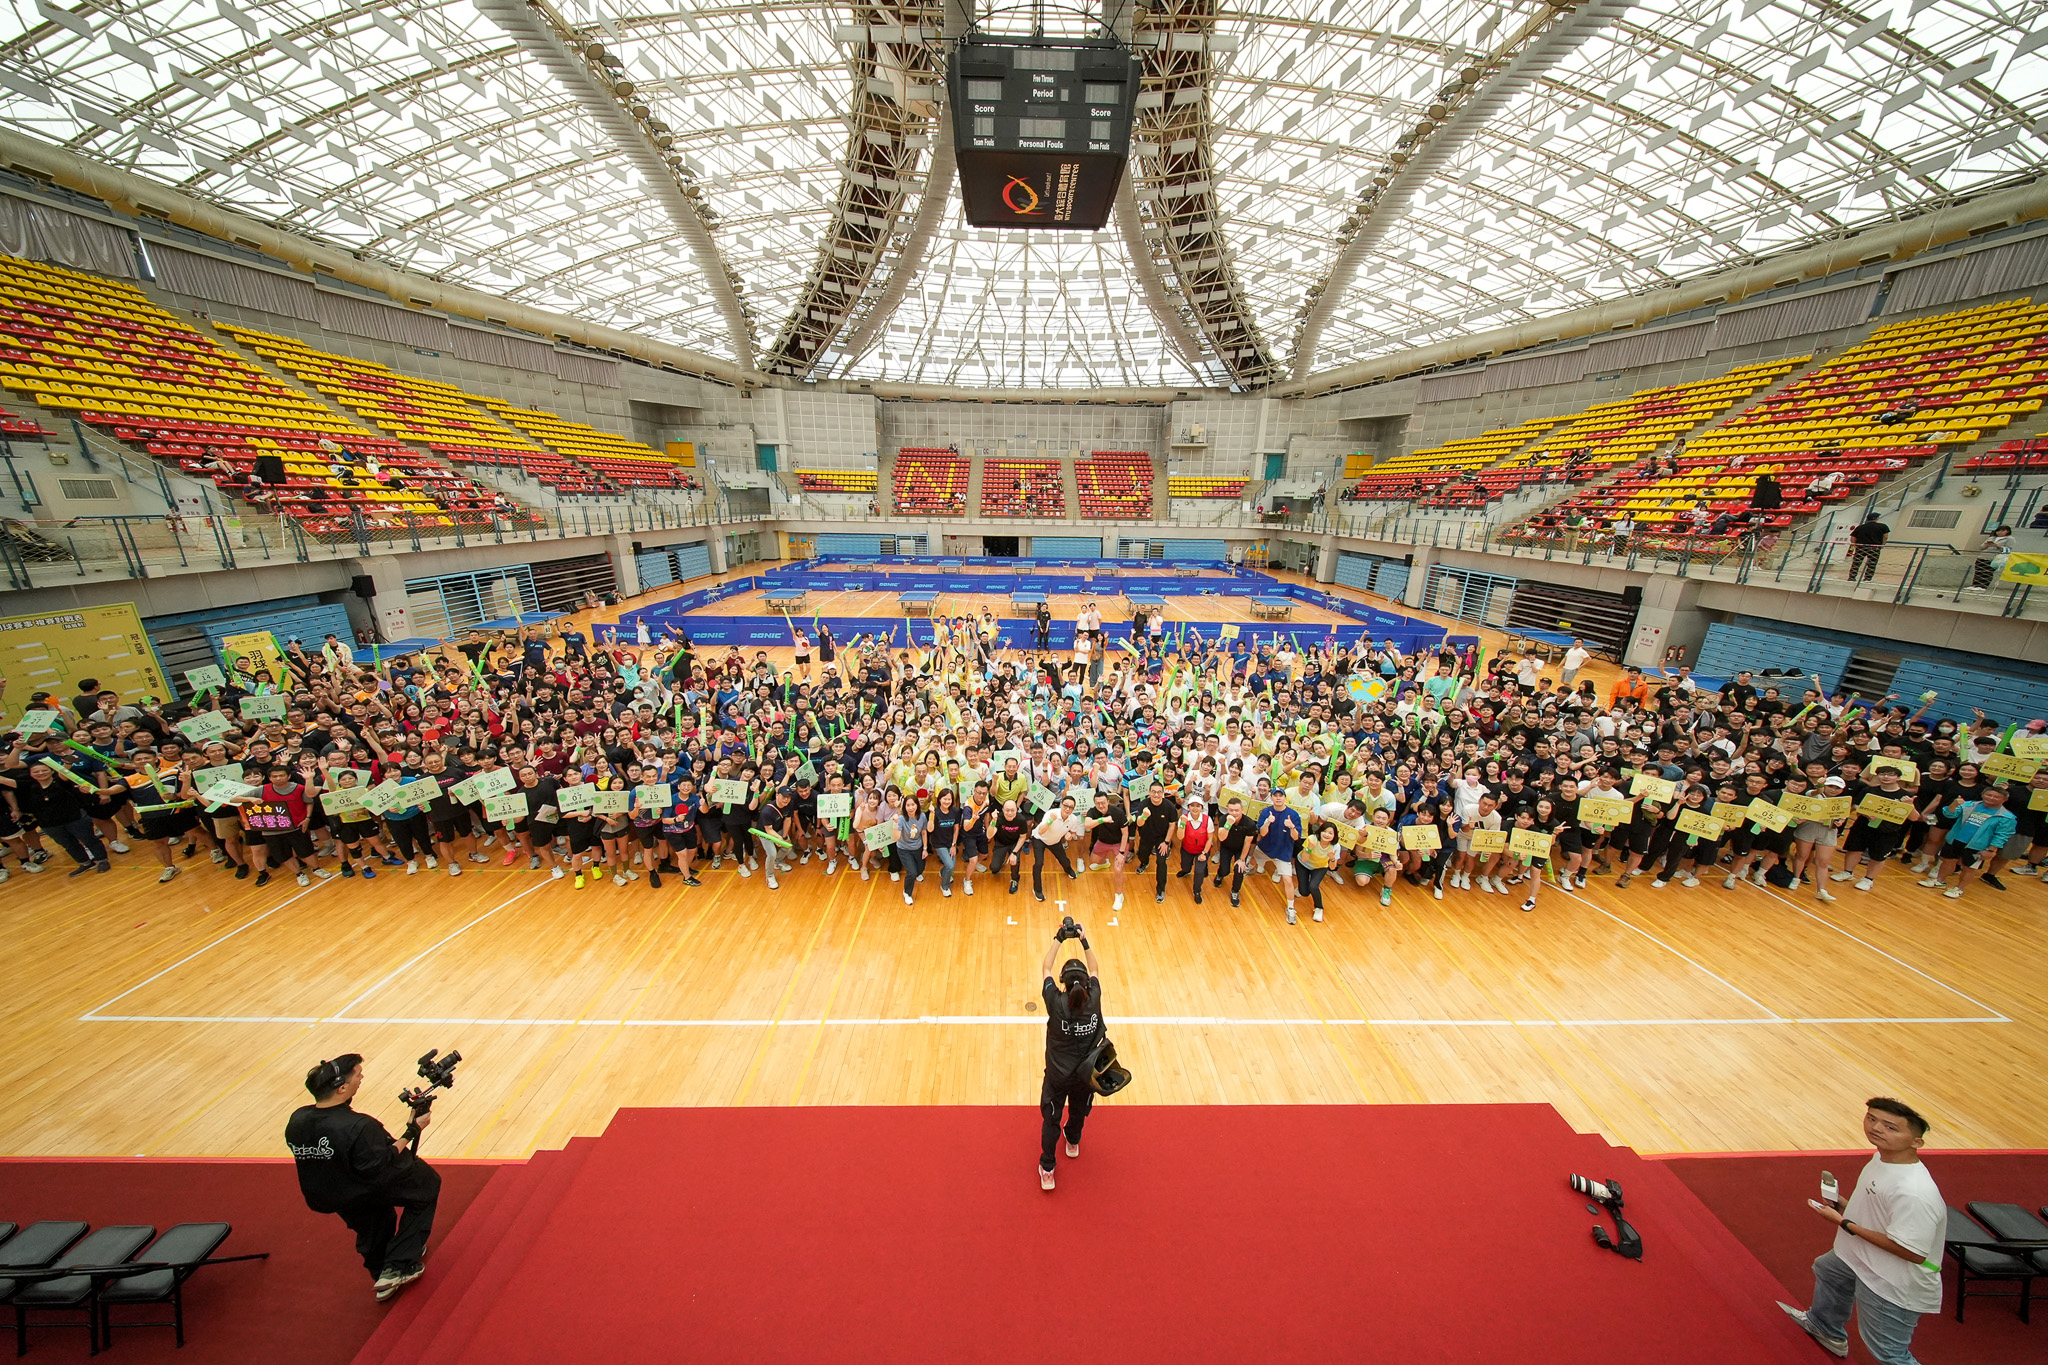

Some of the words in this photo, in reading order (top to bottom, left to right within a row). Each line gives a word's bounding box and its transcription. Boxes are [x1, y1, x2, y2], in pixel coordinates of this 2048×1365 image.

[1032, 74, 1041, 83] Free
[1041, 74, 1054, 83] Throws
[1032, 88, 1054, 98] Period
[974, 104, 995, 113] Score
[1090, 108, 1111, 117] Score
[973, 138, 984, 146] Team
[984, 138, 995, 147] Fouls
[1018, 139, 1046, 149] Personal
[1046, 140, 1064, 149] Fouls
[1089, 141, 1099, 149] Team
[1099, 142, 1110, 150] Fouls
[1069, 163, 1080, 189] CENTER
[1065, 189, 1076, 210] SPORTS
[1064, 210, 1072, 221] NTU
[653, 606, 672, 616] DONIC
[1354, 609, 1370, 617] DONIC
[1375, 616, 1397, 626] DONIC
[248, 649, 268, 669] 羽球
[198, 722, 212, 731] 16
[2003, 763, 2017, 772] 21
[489, 779, 501, 787] 03
[412, 788, 425, 796] 23
[724, 788, 734, 796] 21
[1646, 784, 1658, 793] 02
[338, 797, 352, 805] 06
[377, 792, 391, 801] 22
[572, 793, 583, 801] 07
[1794, 803, 1807, 811] 20
[1876, 805, 1891, 813] 24
[1723, 811, 1733, 819] 17
[1761, 810, 1774, 820] 05
[1693, 820, 1705, 829] 23
[876, 832, 887, 840] 25
[1375, 836, 1385, 844] 16
[1525, 839, 1535, 847] 01
